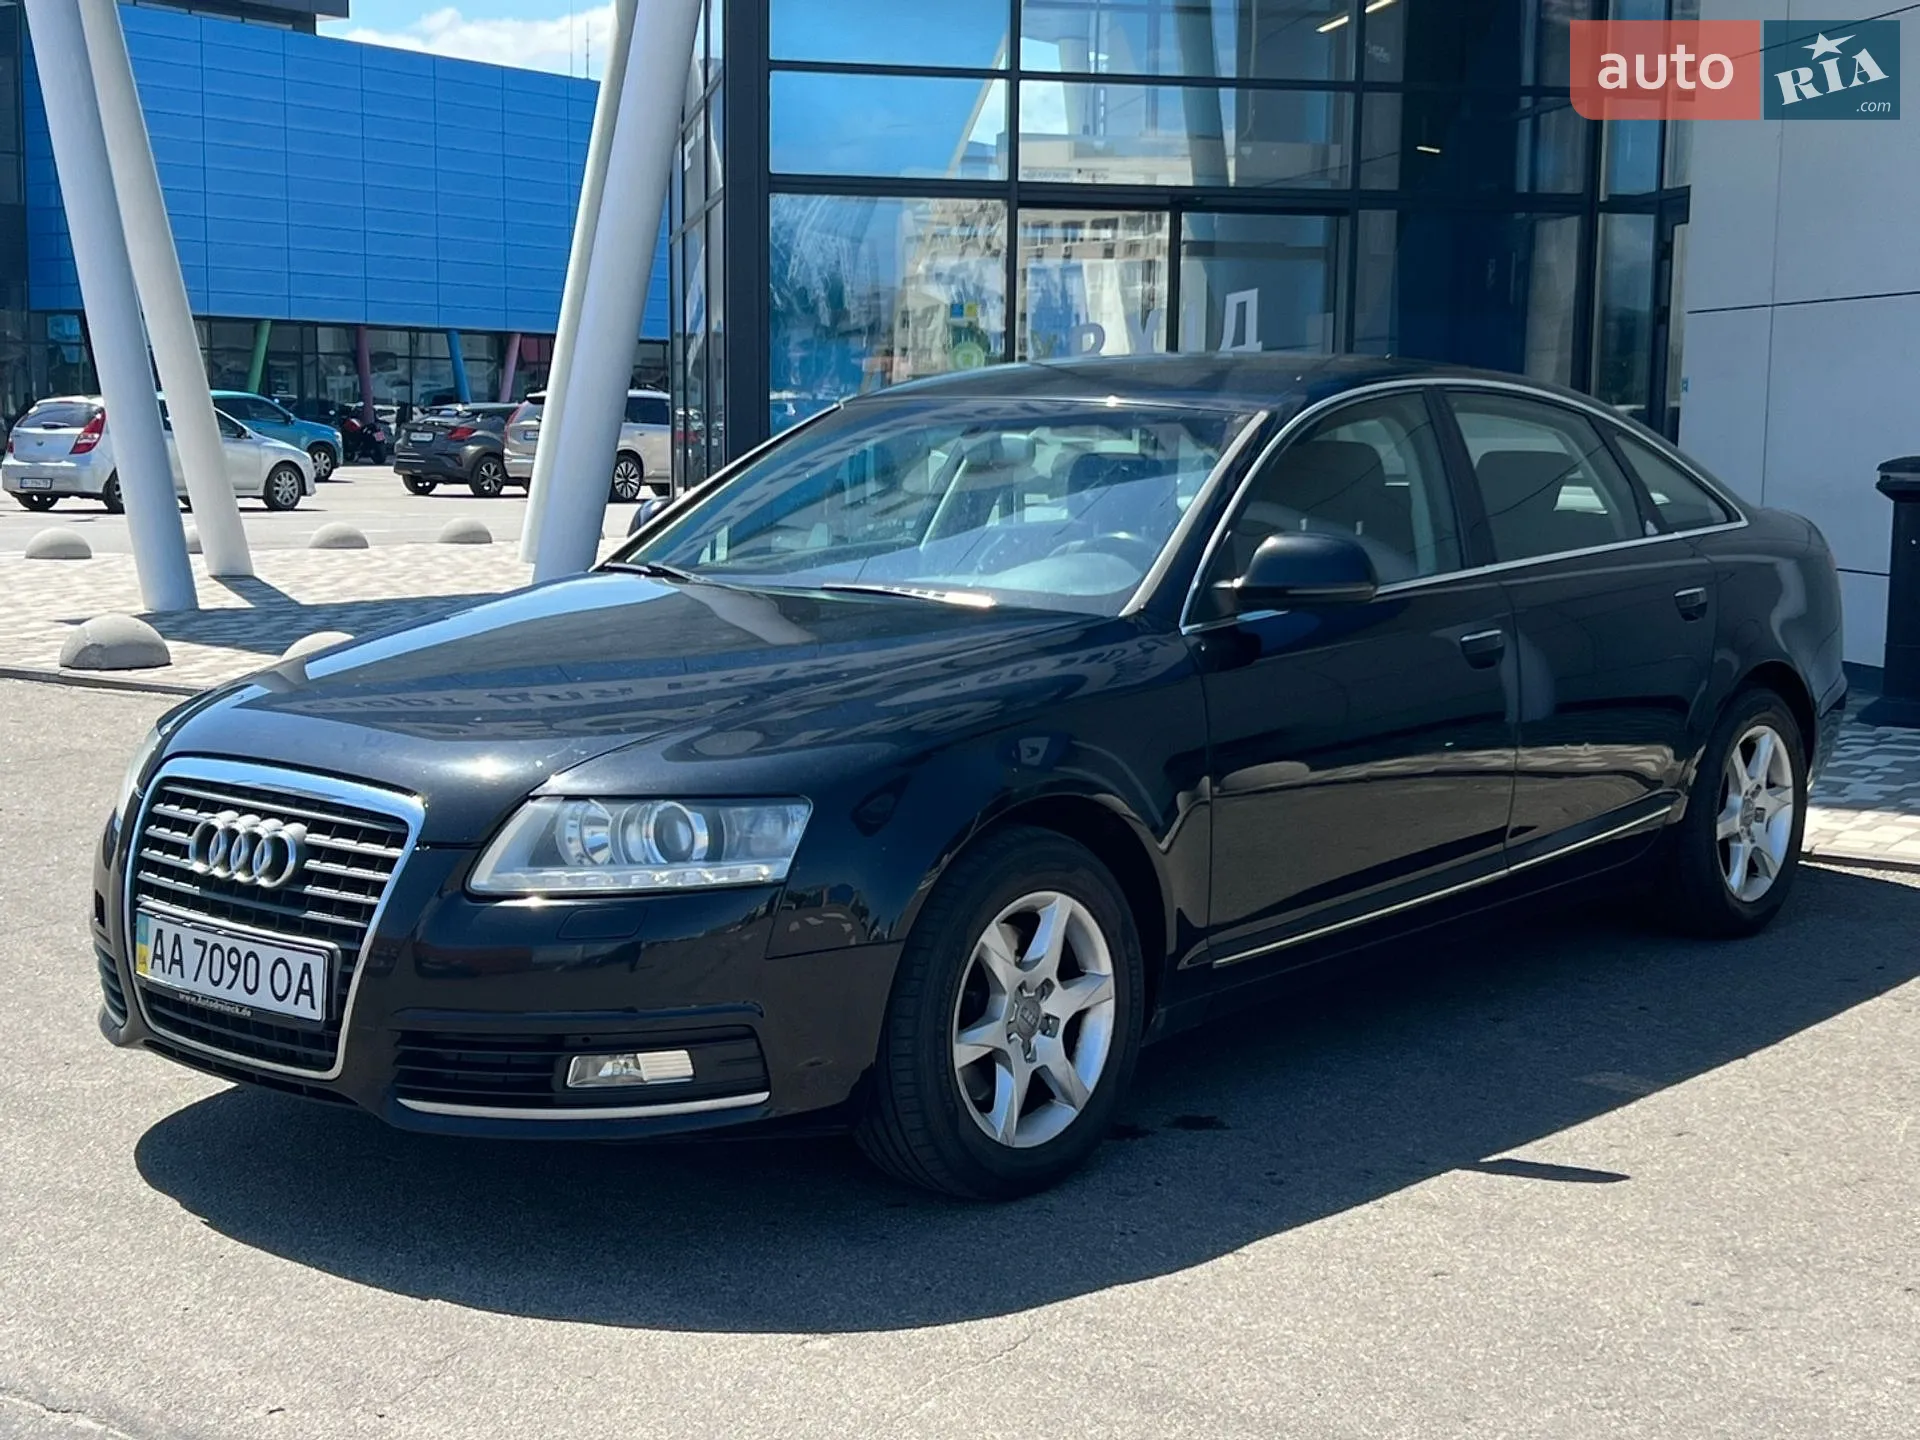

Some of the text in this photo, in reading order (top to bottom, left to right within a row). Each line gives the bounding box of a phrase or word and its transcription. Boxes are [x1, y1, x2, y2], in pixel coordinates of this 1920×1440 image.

[151, 928, 316, 1010] AA 7090 OA
